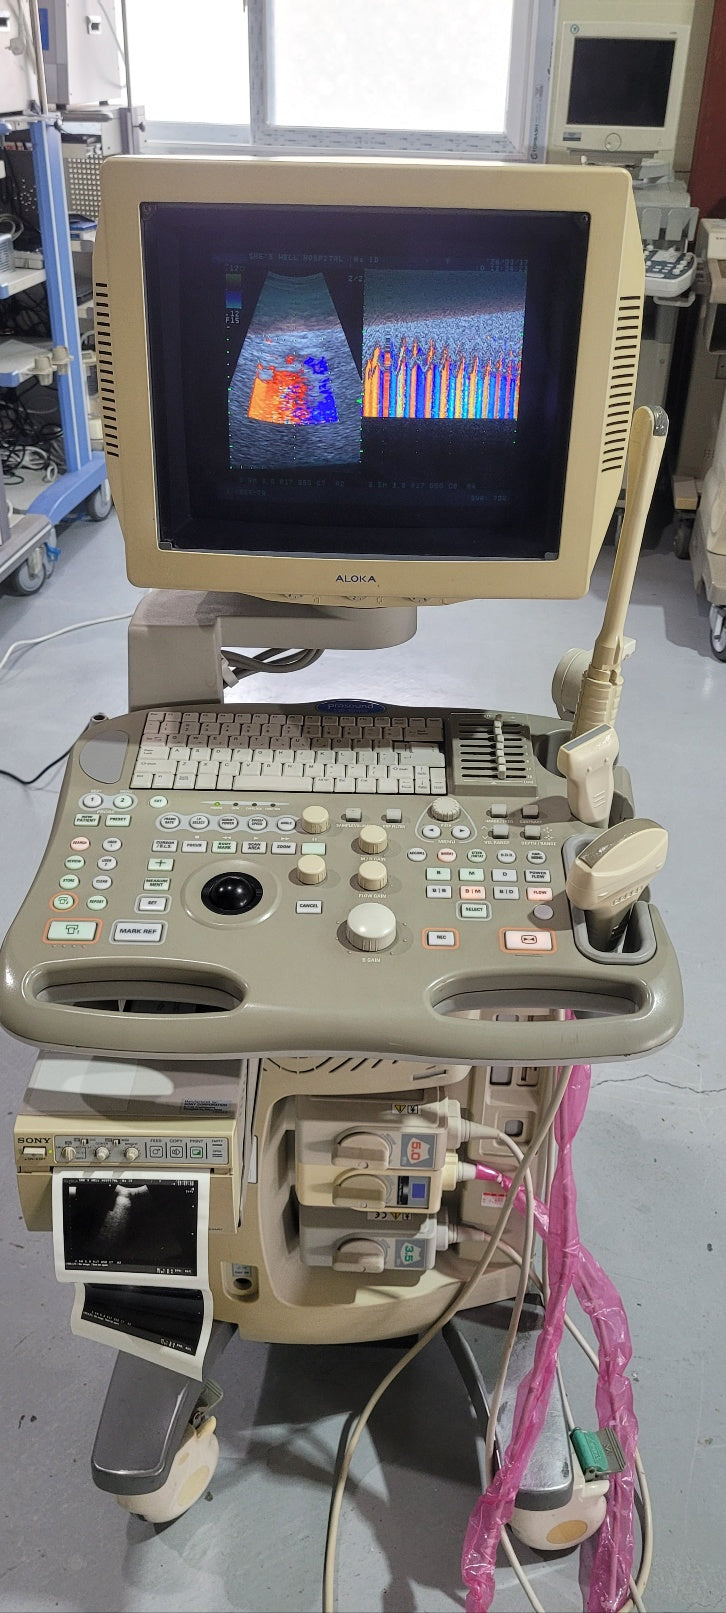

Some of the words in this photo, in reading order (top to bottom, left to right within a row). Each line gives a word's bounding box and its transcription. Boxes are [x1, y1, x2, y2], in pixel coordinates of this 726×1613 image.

[304, 254, 343, 262] HOSPITAL
[335, 574, 376, 582] ALOKA
[411, 1141, 421, 1161] 5.0
[405, 1246, 414, 1262] 3.5
